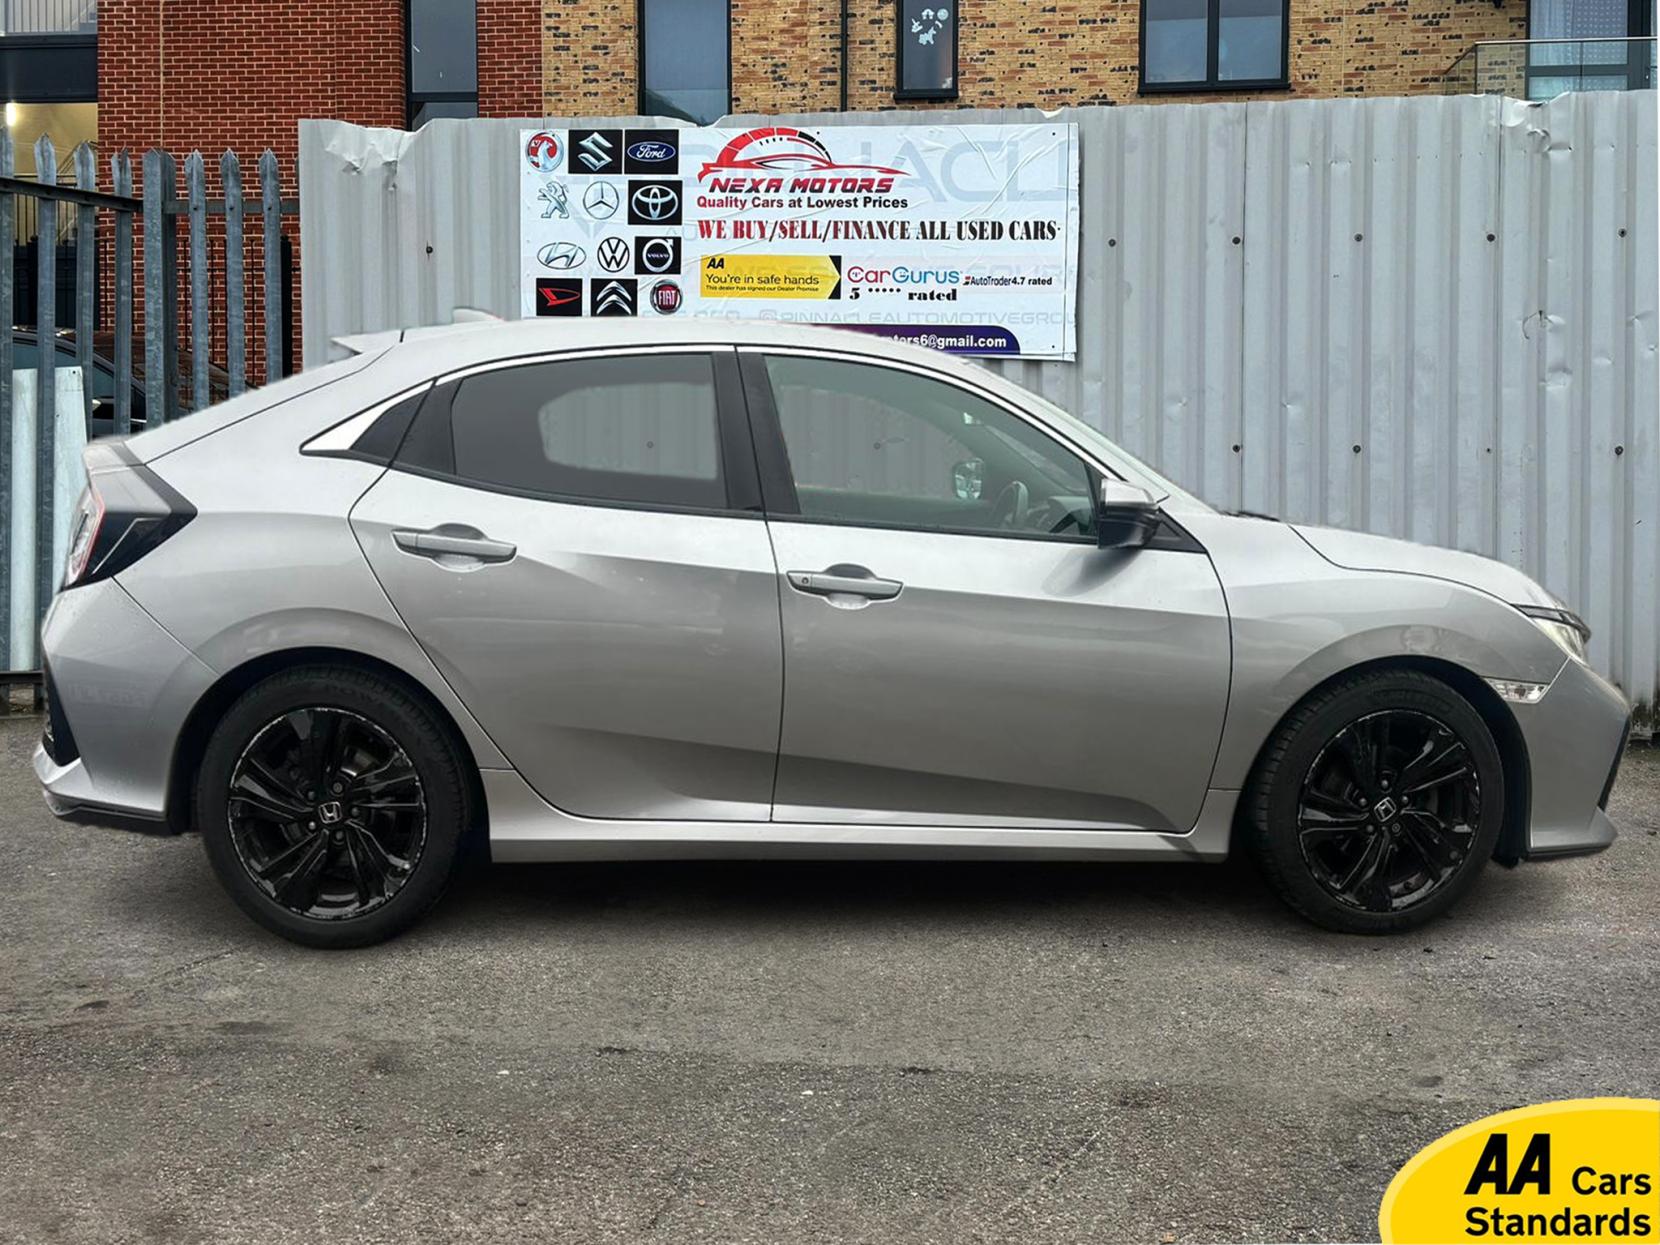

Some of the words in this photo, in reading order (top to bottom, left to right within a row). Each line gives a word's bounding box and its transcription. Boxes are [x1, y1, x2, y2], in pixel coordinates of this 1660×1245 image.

[636, 144, 666, 158] Ford
[709, 178, 783, 193] NEXA
[789, 178, 895, 193] MOTORS
[697, 196, 747, 210] Quality
[752, 196, 784, 209] Cars
[788, 197, 802, 209] at
[807, 196, 858, 209] Lowest
[863, 196, 908, 209] Prices
[698, 220, 726, 240] WE
[916, 220, 950, 240] ALL
[956, 220, 1004, 240] USED
[1009, 220, 1056, 240] CARS
[707, 258, 724, 269] AA
[706, 274, 741, 284] You're
[744, 274, 754, 284] in
[757, 274, 781, 285] safe
[784, 275, 819, 285] hands
[847, 266, 960, 284] CarGurus
[1028, 276, 1052, 285] rated
[658, 290, 676, 305] FIAT
[849, 288, 860, 300] 5
[908, 289, 957, 300] rated
